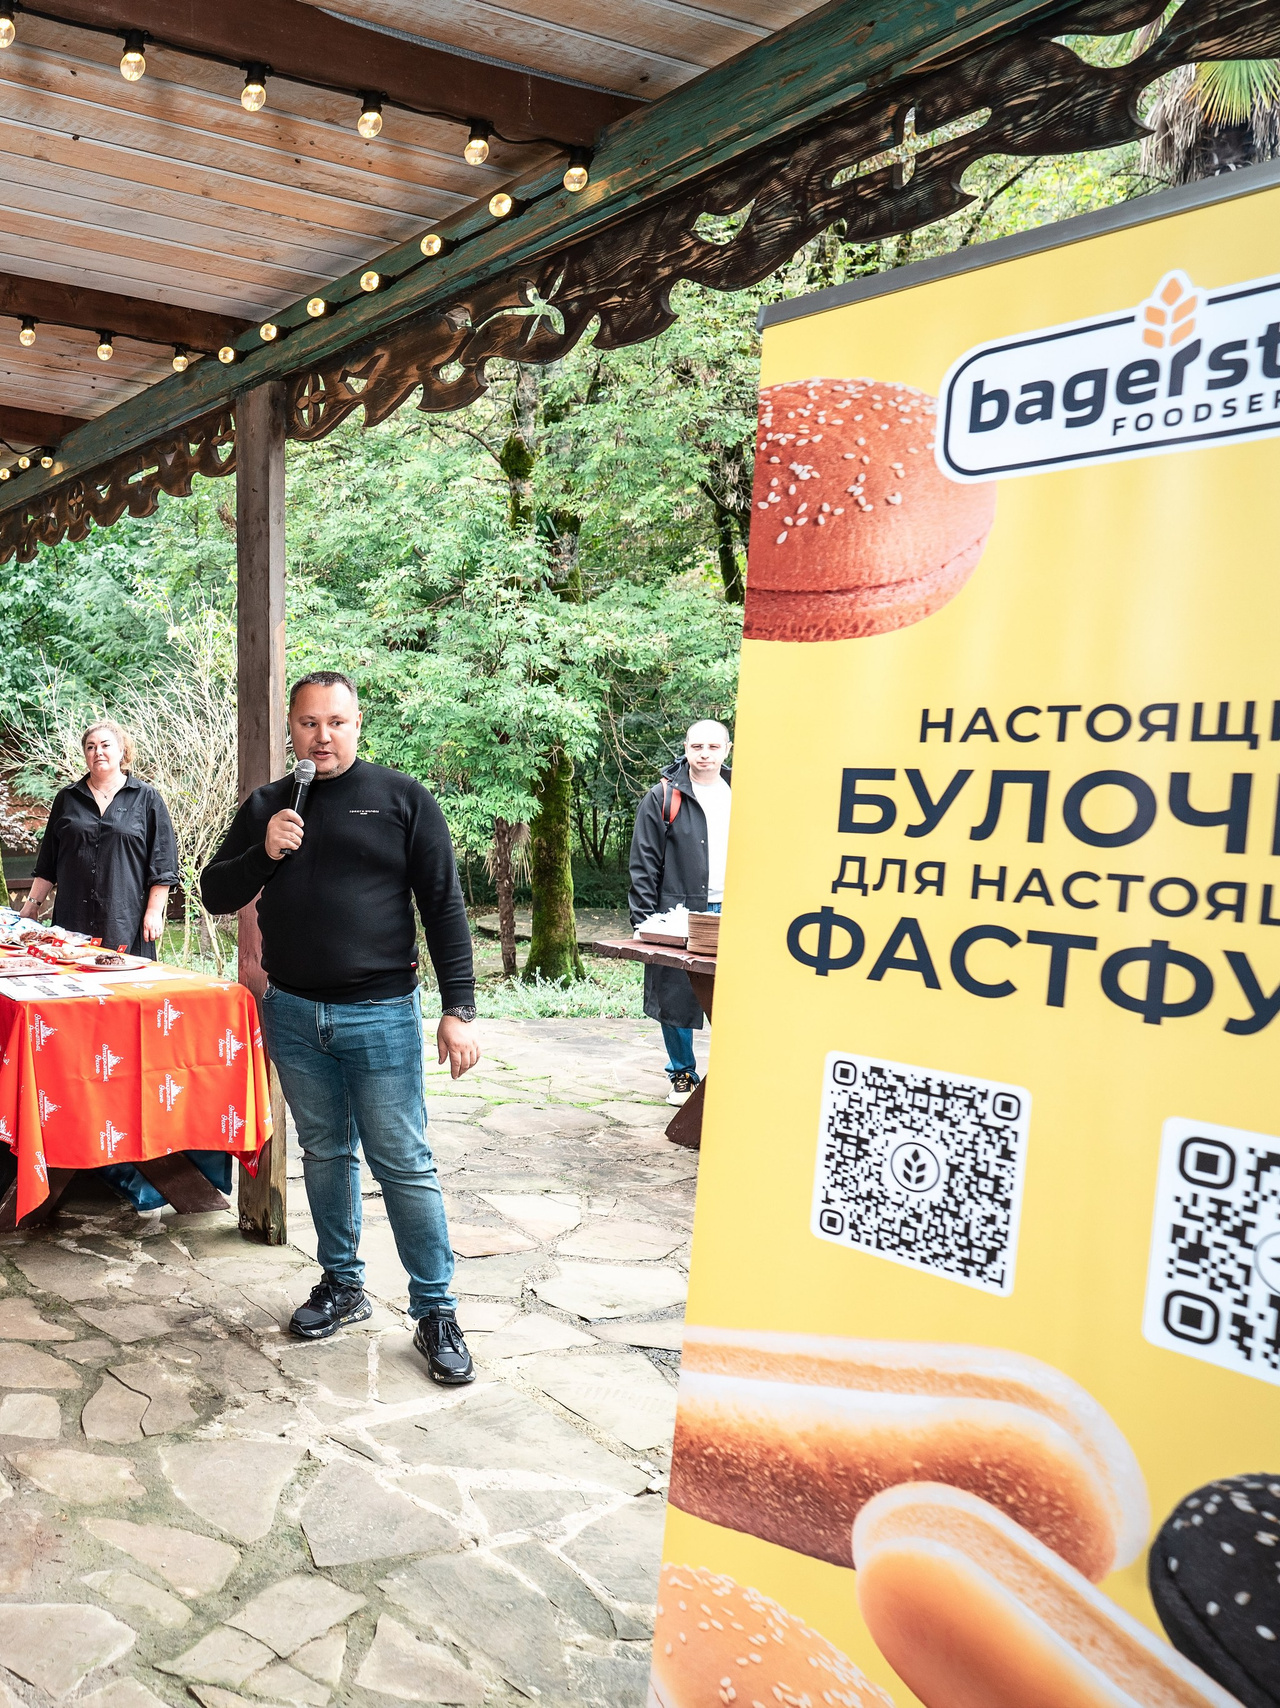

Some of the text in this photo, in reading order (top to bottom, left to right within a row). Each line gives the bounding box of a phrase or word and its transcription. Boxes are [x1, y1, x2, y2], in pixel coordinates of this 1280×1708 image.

[837, 767, 1280, 857] БУЛОЧ
[831, 855, 947, 897] ДЛЯ
[786, 905, 1280, 1036] ФАСТФУ
